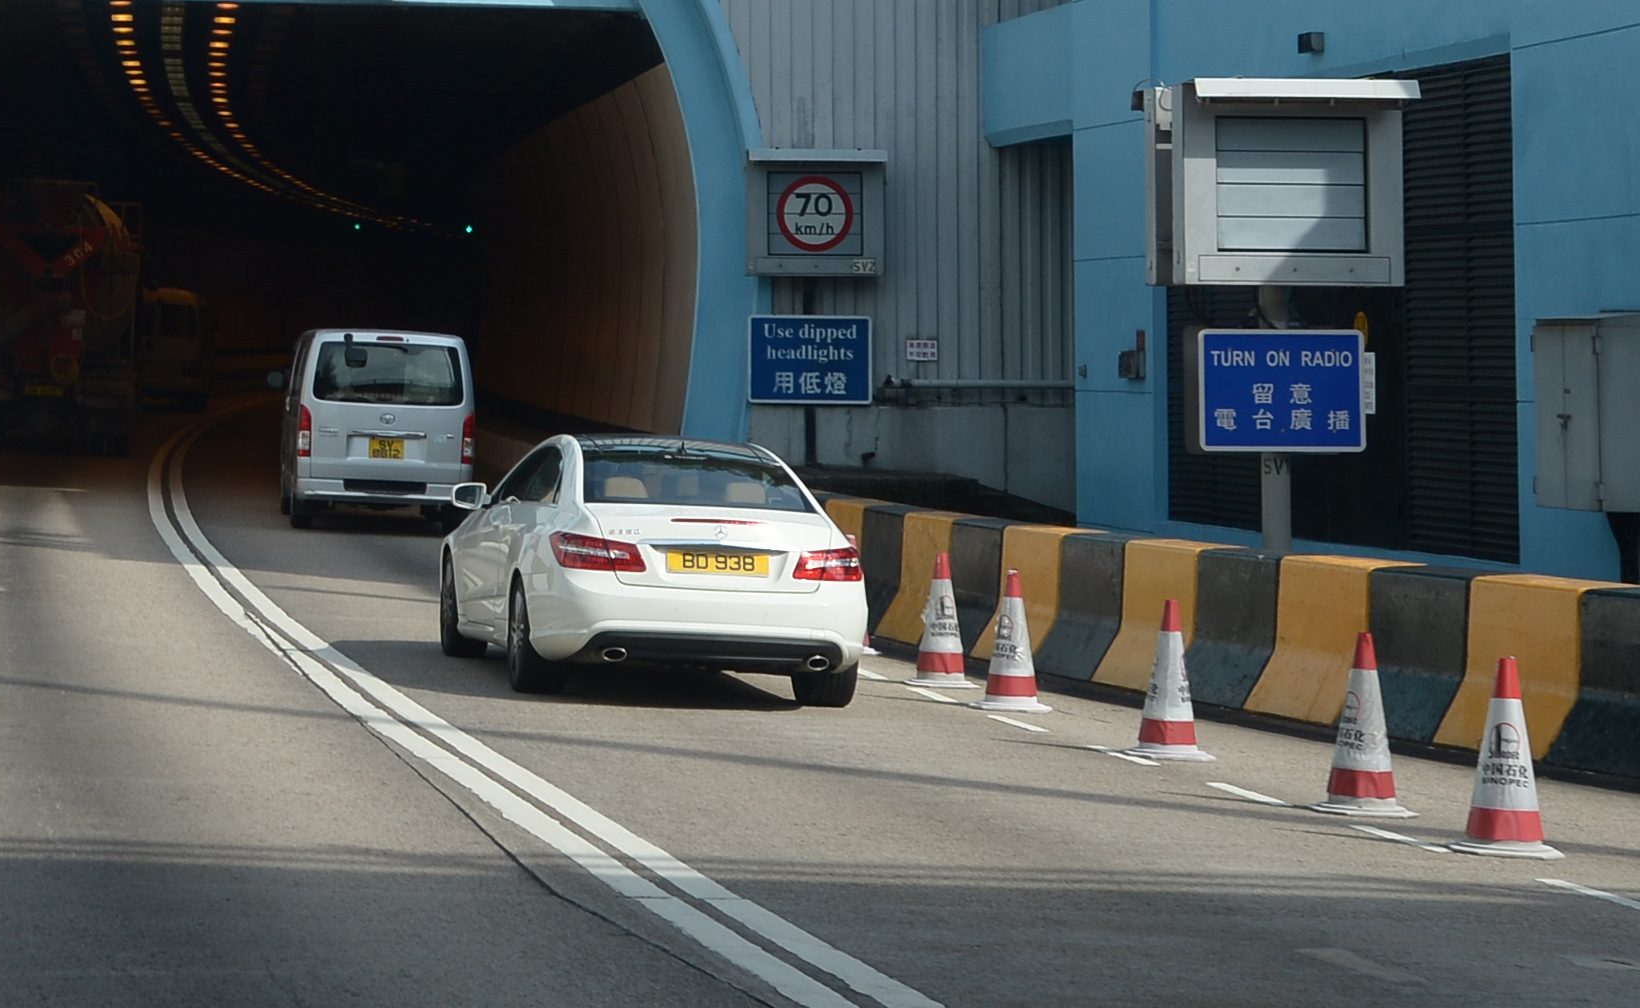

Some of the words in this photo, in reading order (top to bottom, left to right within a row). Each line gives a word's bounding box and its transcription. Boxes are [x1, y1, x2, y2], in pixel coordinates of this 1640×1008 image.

[795, 193, 833, 217] 70
[795, 222, 834, 236] km/h
[764, 323, 794, 338] Use
[798, 323, 857, 343] dipped
[766, 345, 854, 363] headlights
[1211, 350, 1255, 366] TURN
[1266, 351, 1290, 366] ON
[1301, 351, 1353, 367] RADIO
[773, 372, 847, 394] 用低燈
[1252, 383, 1312, 404] 留意
[1214, 408, 1350, 430] 電台廣播
[682, 552, 709, 570] BD
[715, 554, 755, 572] 938
[1481, 777, 1528, 788] SINOPEC
